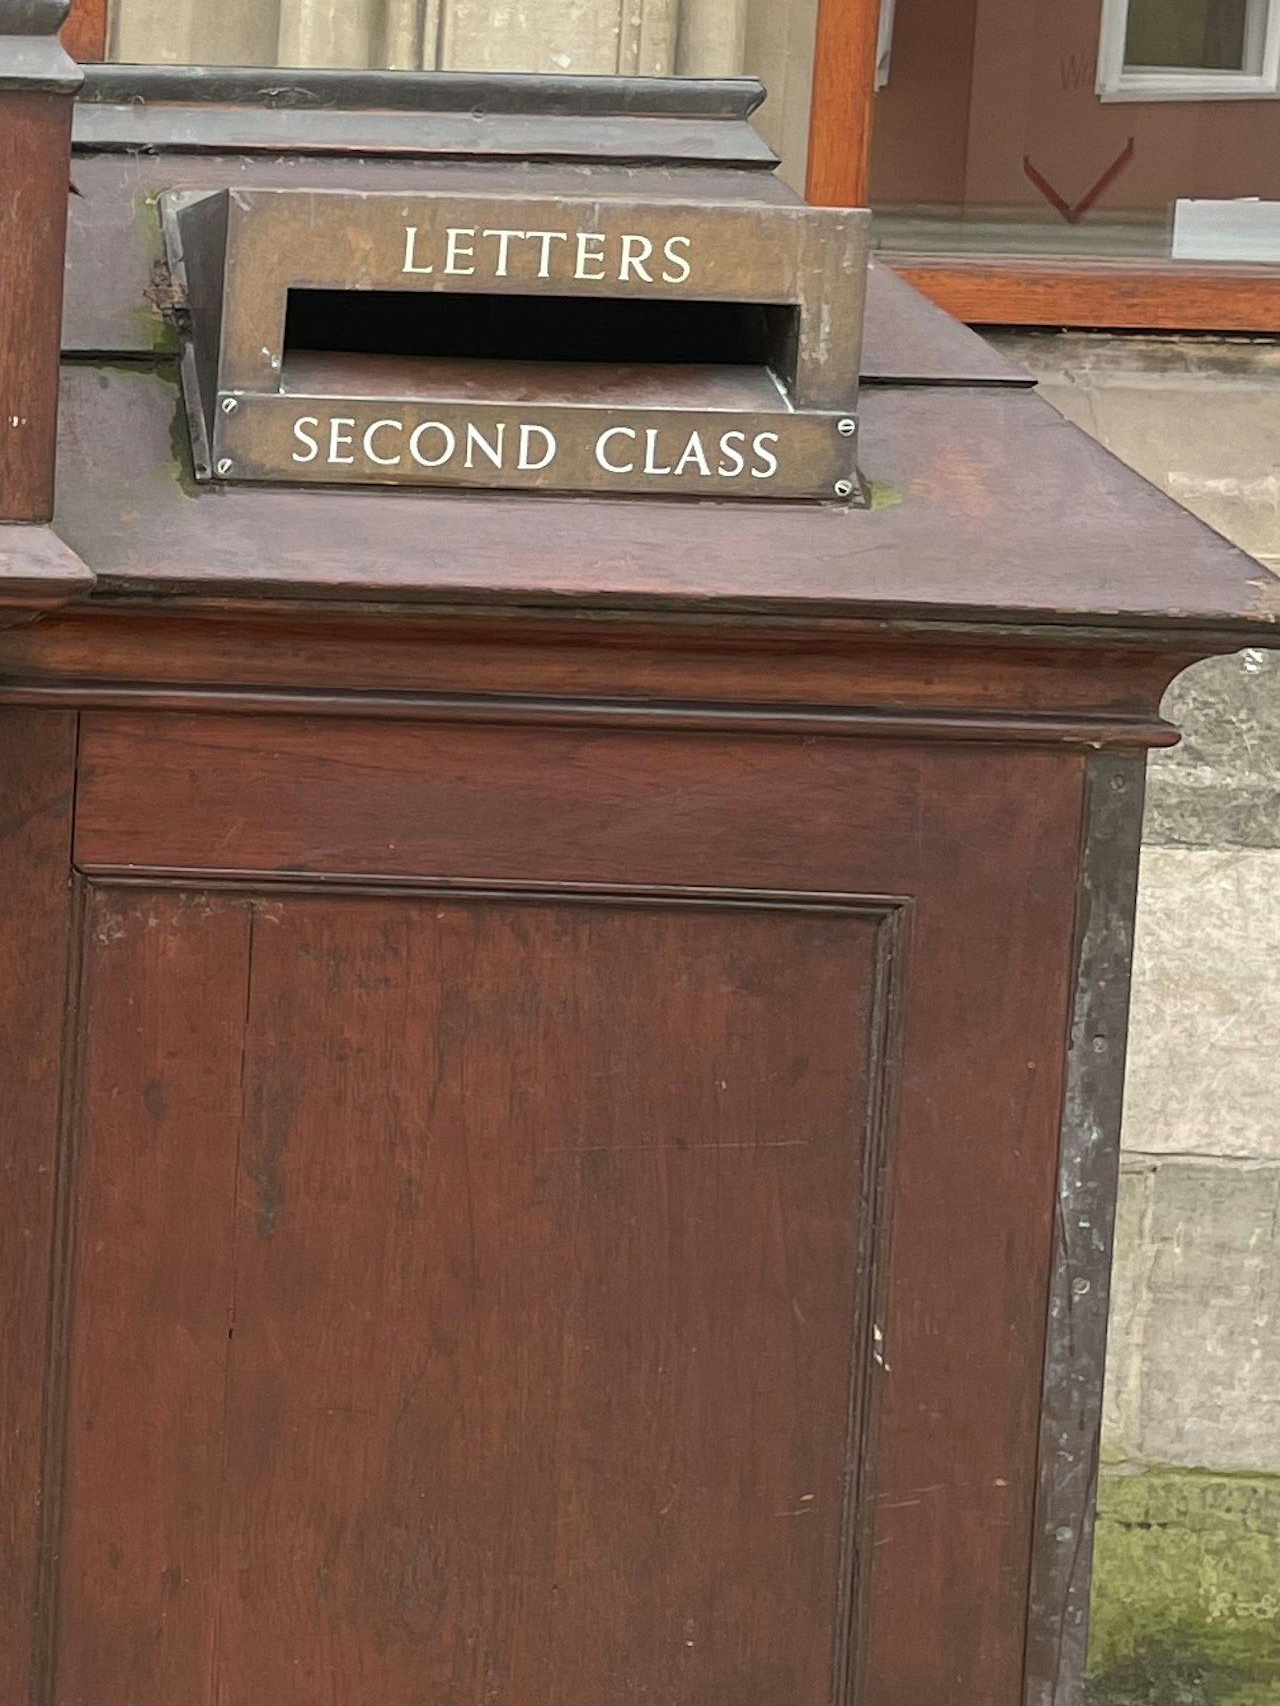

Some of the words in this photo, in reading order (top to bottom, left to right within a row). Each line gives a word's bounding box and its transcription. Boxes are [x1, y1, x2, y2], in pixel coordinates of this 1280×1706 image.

[401, 226, 693, 284] LETTERS
[291, 417, 557, 470] SECOND
[595, 426, 780, 479] CLASS
